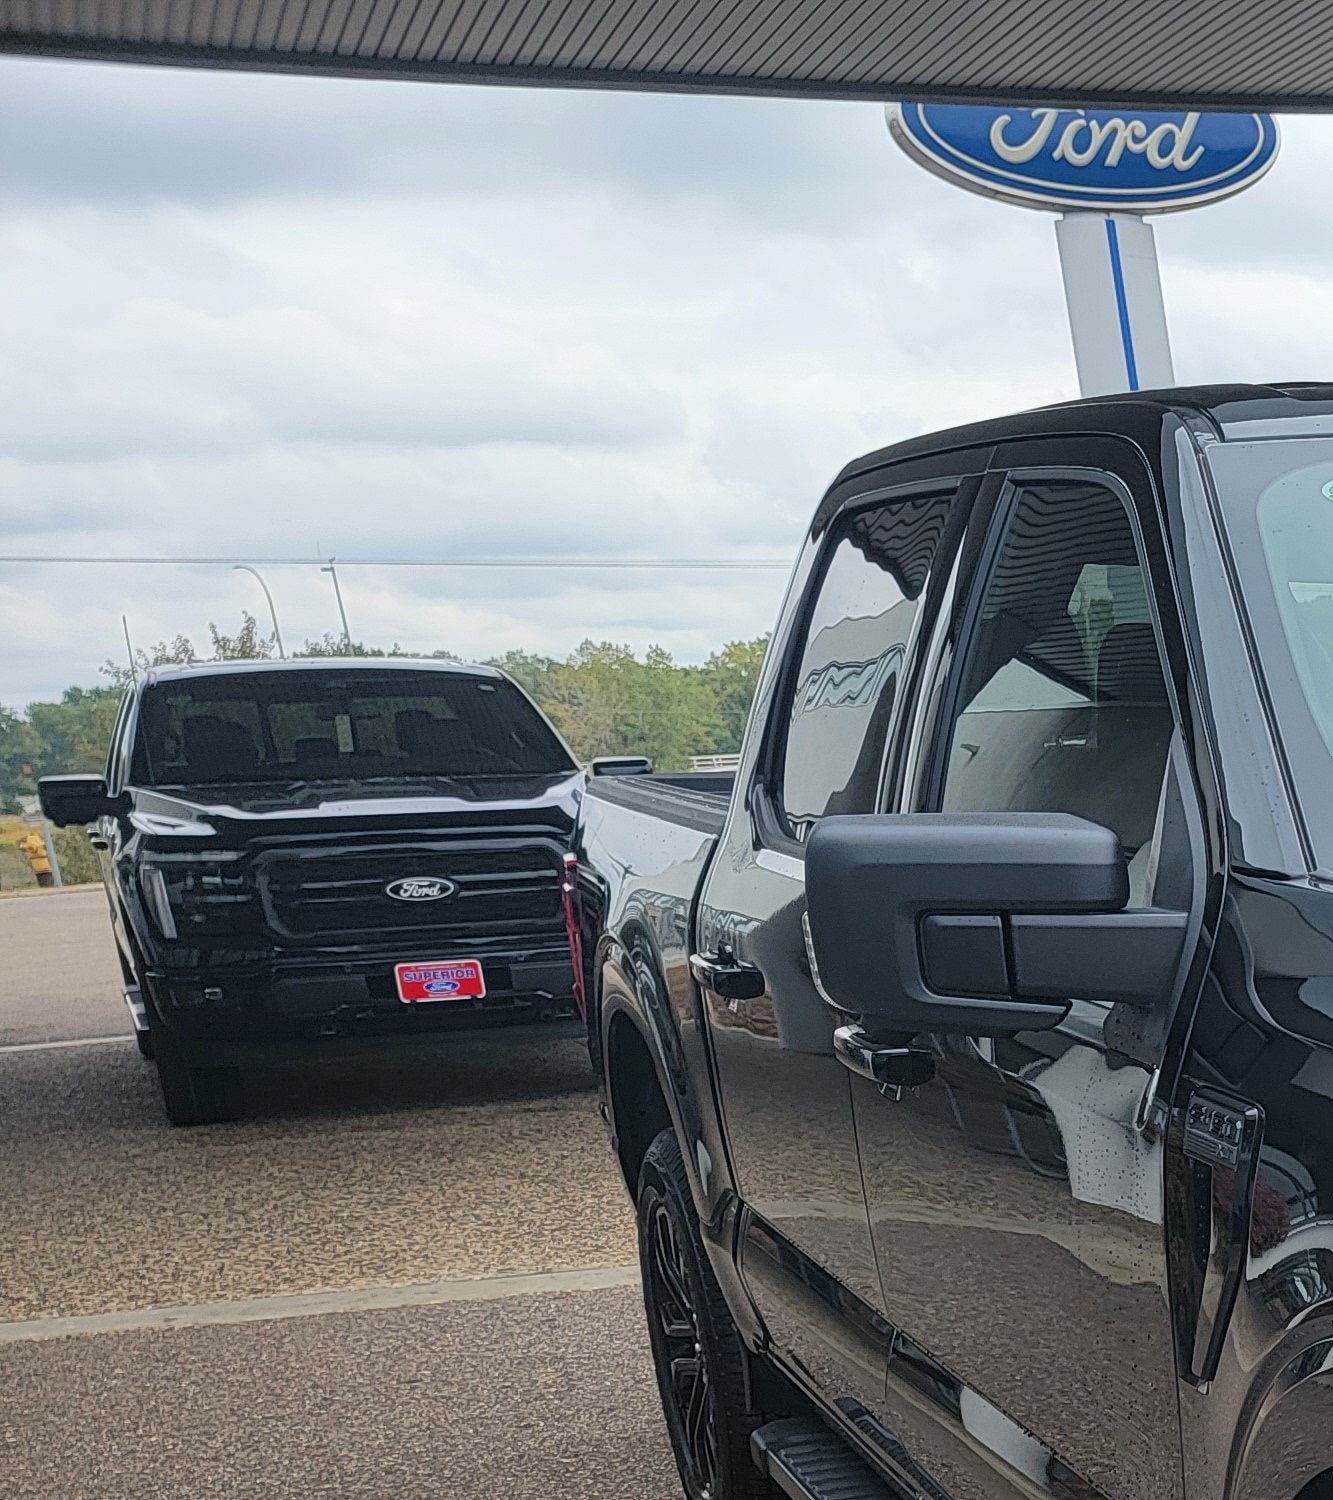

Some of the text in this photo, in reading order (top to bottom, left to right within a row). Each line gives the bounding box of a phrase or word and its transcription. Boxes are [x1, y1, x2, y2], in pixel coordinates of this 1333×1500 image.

[989, 107, 1205, 172] Ford
[399, 880, 441, 898] Ford
[403, 968, 477, 984] SUPERIOR
